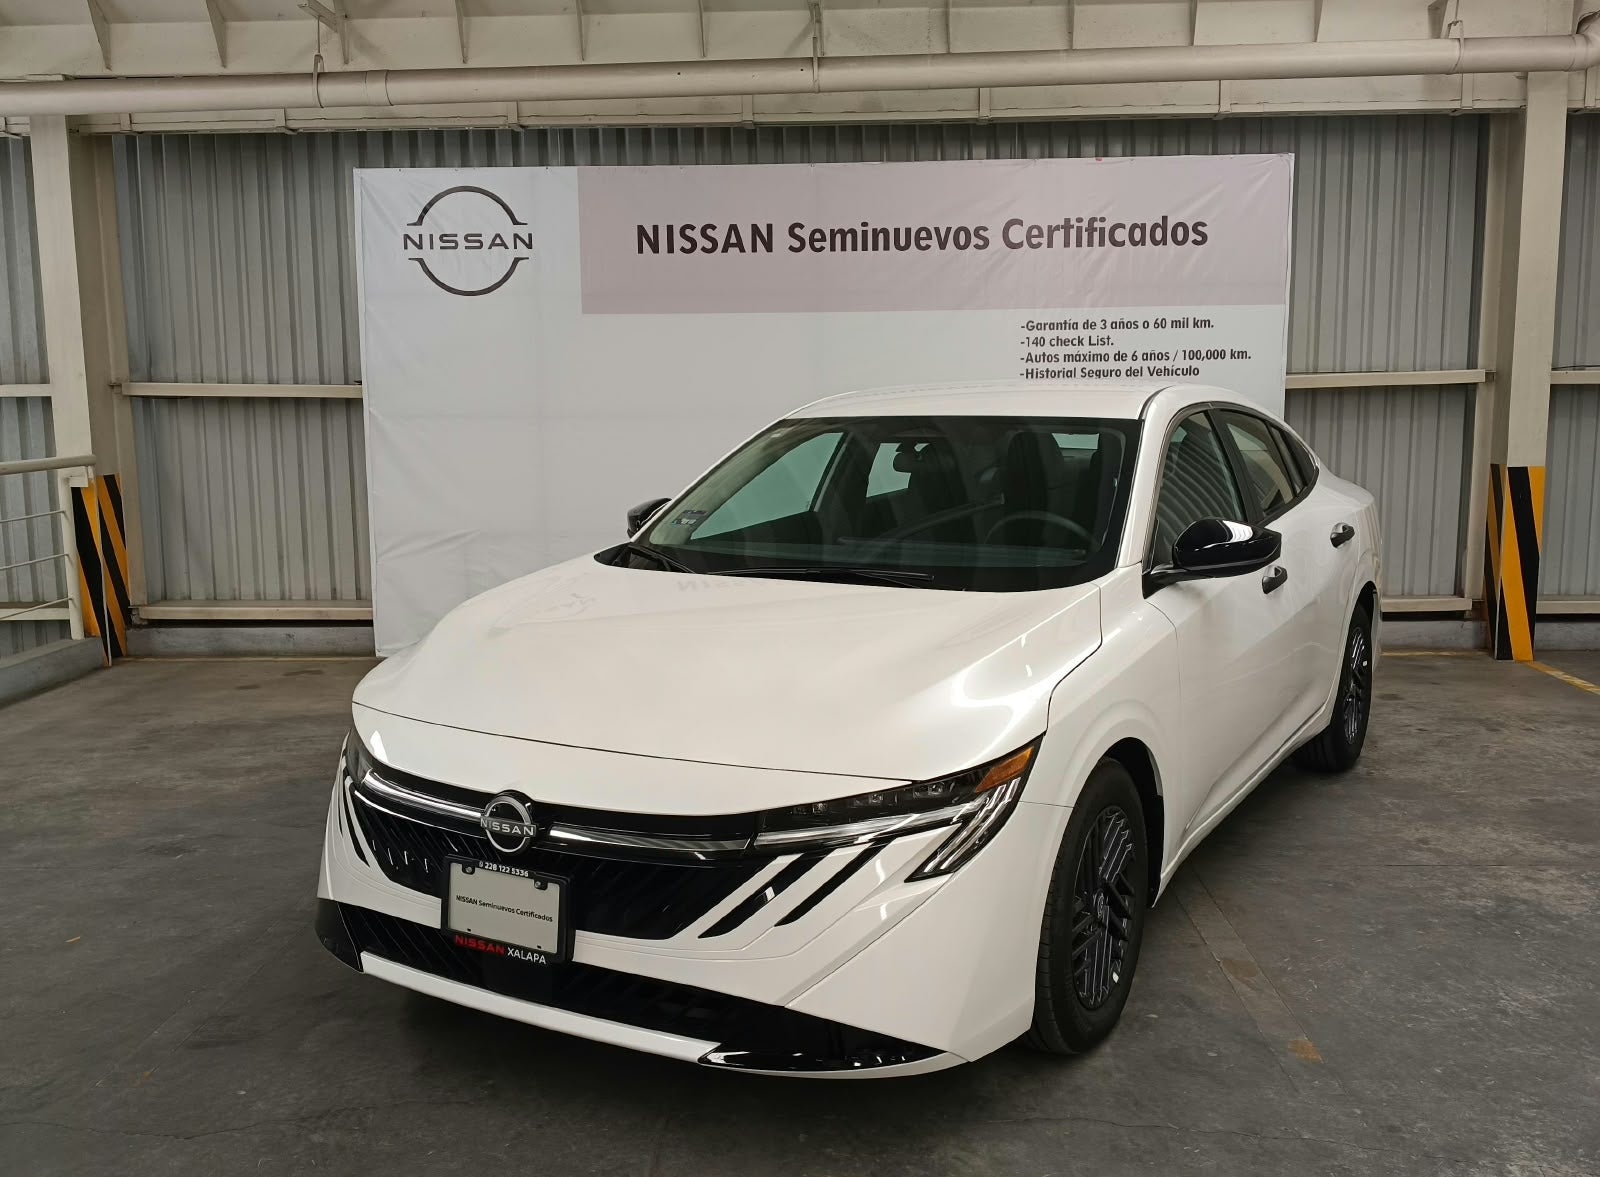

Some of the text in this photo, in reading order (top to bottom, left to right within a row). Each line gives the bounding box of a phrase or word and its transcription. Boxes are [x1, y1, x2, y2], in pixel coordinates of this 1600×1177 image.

[403, 232, 533, 250] NISSAN
[637, 215, 1208, 254] NISSAN Seminuevos Certificados
[1020, 316, 1214, 331] -Garantía de 3 años o 60 mil km.
[1020, 334, 1115, 347] -140 check List.
[1020, 348, 1252, 363] -Autos máximo de 6 años / 100,000 km.
[1019, 364, 1200, 379] -Historial Seguro del Vehículo
[480, 817, 534, 836] NISSAN
[484, 862, 498, 871] 228
[498, 865, 510, 873] 122
[456, 894, 553, 922] NISSAN Seminuevos Certificados
[455, 934, 547, 964] NISSAN XALAPA
